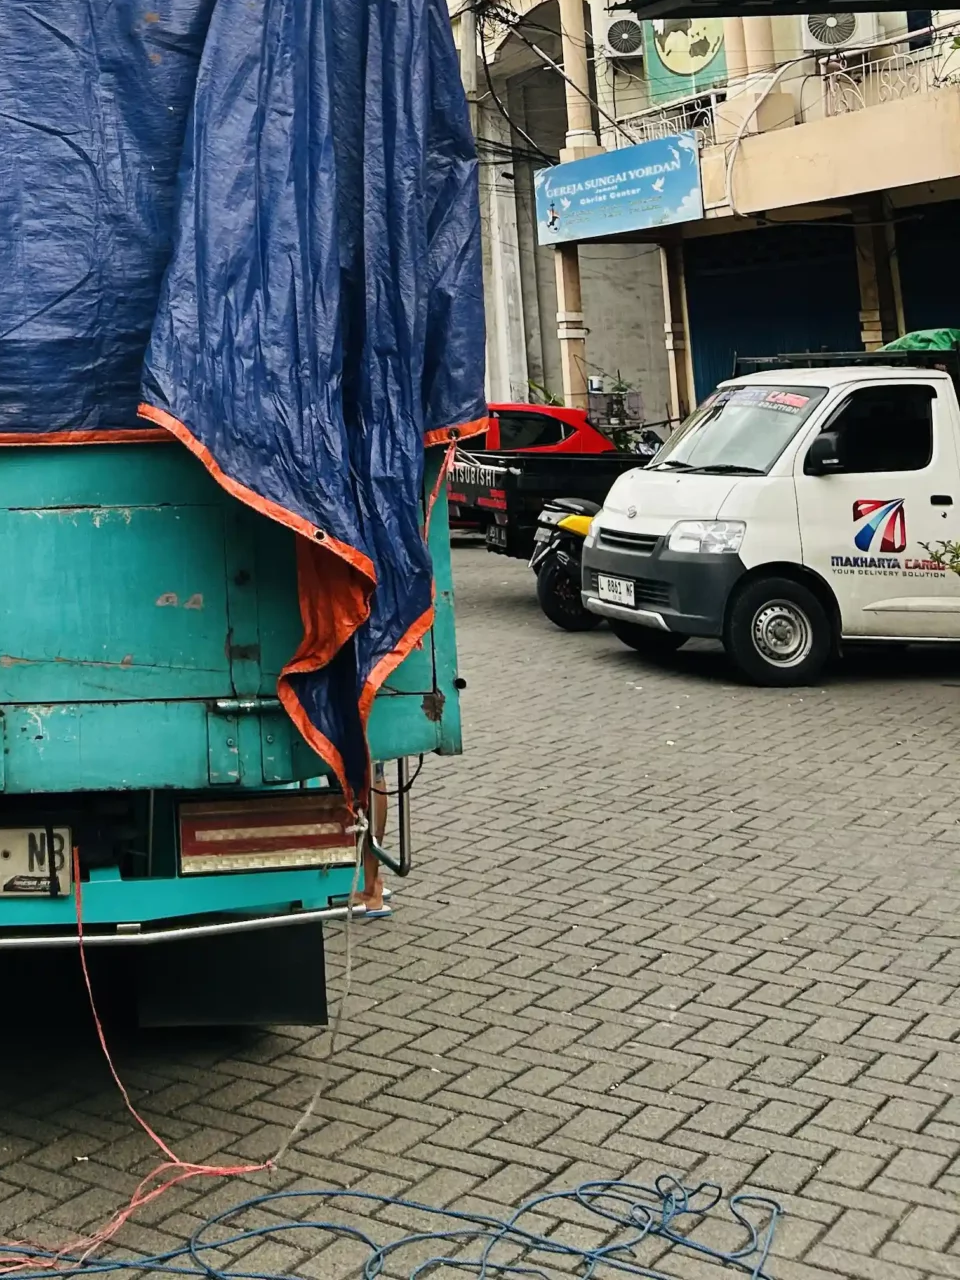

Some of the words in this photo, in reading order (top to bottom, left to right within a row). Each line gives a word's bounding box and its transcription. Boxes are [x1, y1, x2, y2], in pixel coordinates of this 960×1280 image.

[546, 184, 584, 198] GEREJA
[585, 173, 627, 189] SUNGAI
[629, 160, 681, 179] YORDAN
[580, 195, 607, 205] Christ
[610, 187, 641, 199] Center
[831, 556, 901, 569] MAKHARYA
